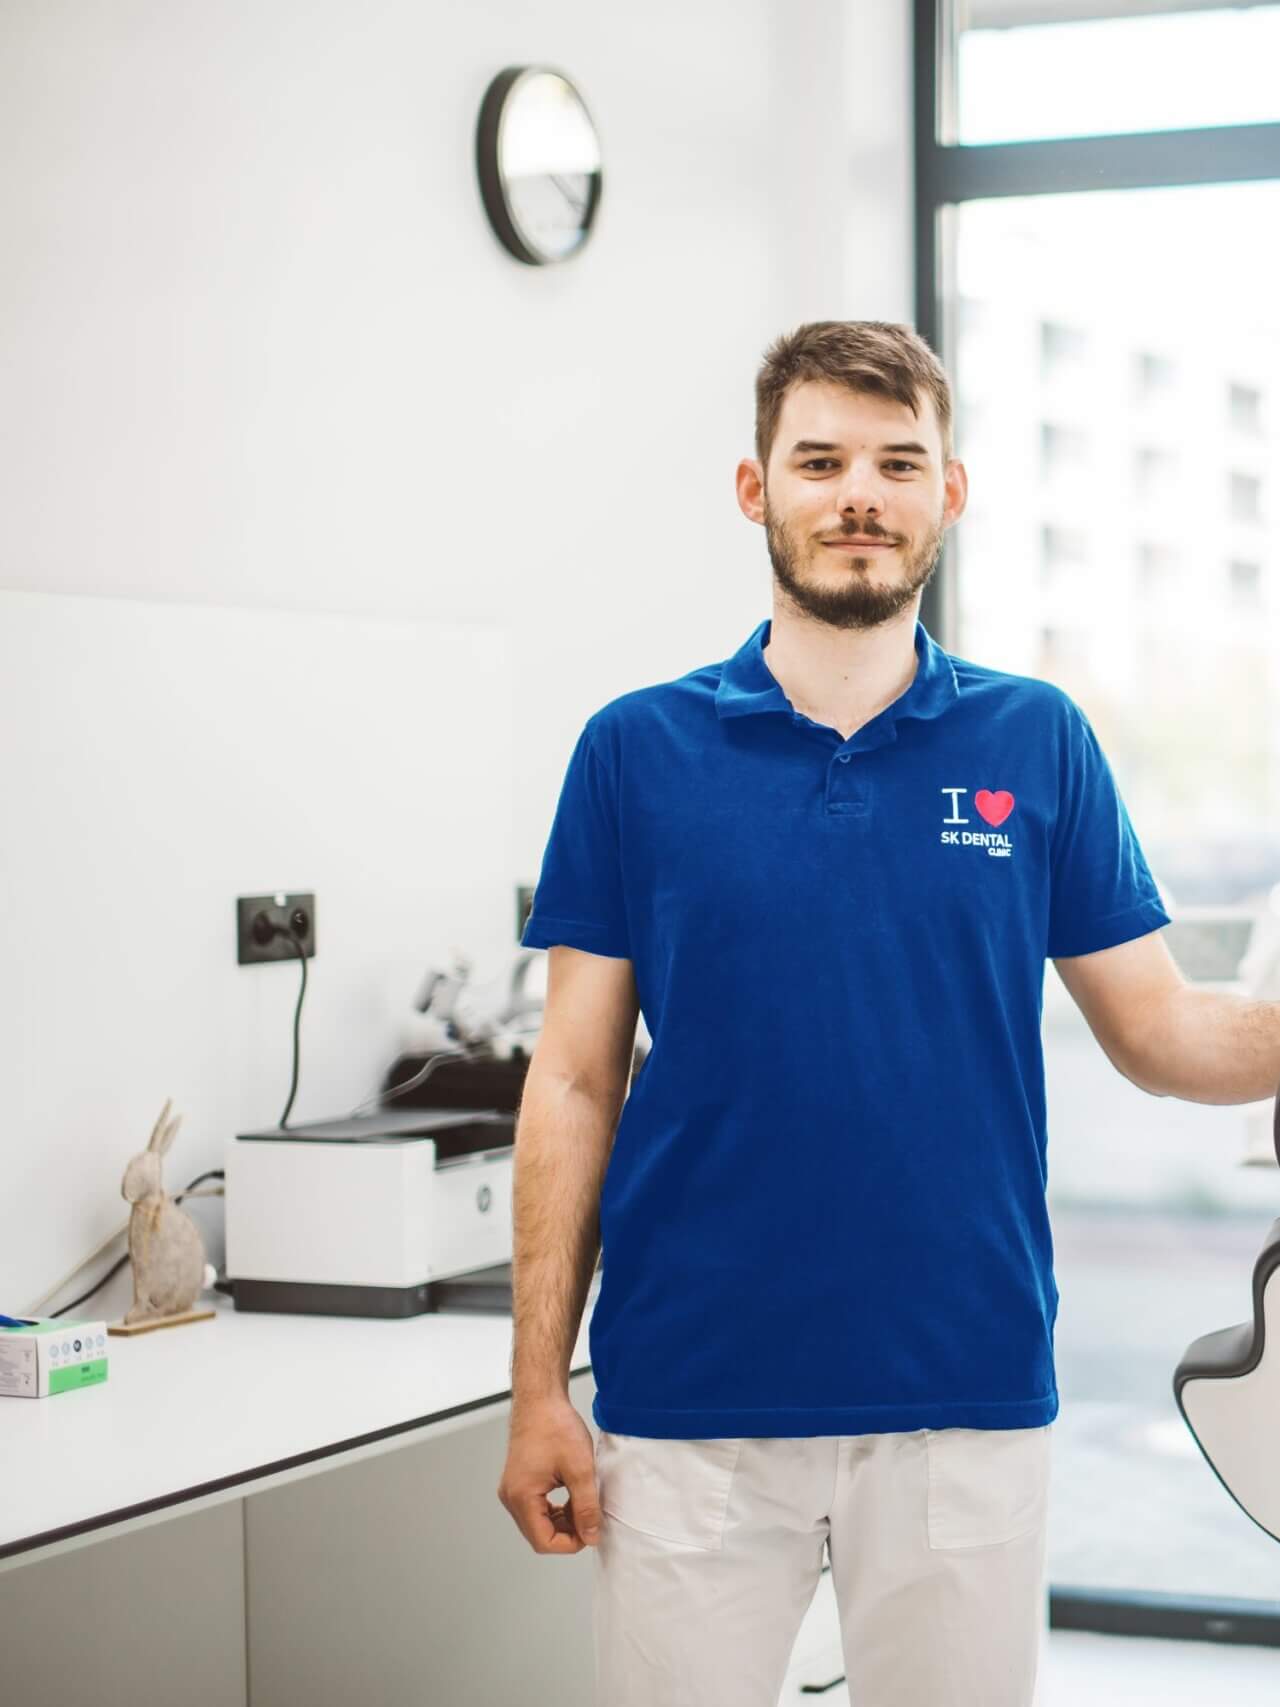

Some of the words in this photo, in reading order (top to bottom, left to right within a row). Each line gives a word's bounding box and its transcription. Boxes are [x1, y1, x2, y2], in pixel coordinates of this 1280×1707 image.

[941, 787, 969, 824] I
[941, 831, 960, 845] SK
[961, 831, 1013, 847] DENTAL
